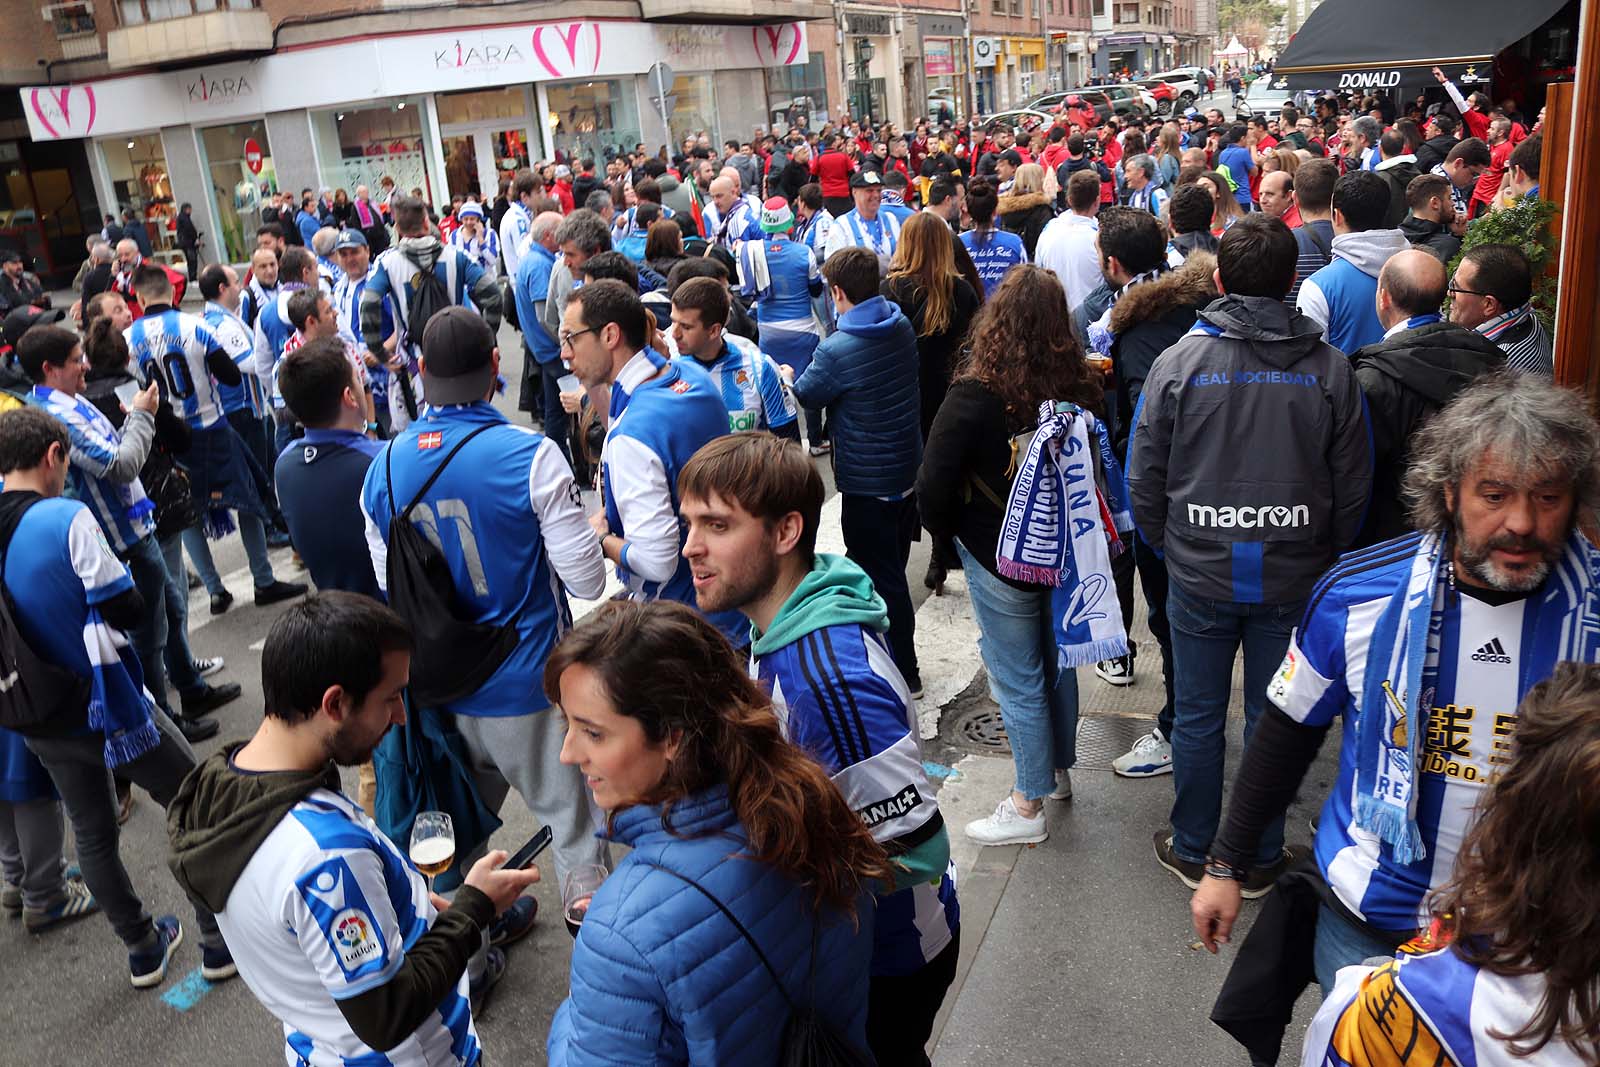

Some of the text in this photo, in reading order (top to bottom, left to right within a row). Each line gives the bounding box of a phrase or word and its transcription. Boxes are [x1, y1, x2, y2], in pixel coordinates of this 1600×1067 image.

[434, 39, 526, 69] KIARA
[186, 73, 253, 102] KIARA
[1338, 71, 1401, 88] DONALD
[1190, 370, 1317, 388] REAL SOCIEDAD
[1030, 446, 1041, 461] DE
[1017, 462, 1036, 498] MARZO
[1012, 500, 1026, 513] DE
[1187, 503, 1310, 529] macron
[1005, 514, 1023, 542] 2020
[1062, 573, 1108, 632] 12
[1471, 652, 1512, 664] adidas
[1377, 775, 1411, 802] RE
[859, 790, 916, 825] ANAL+
